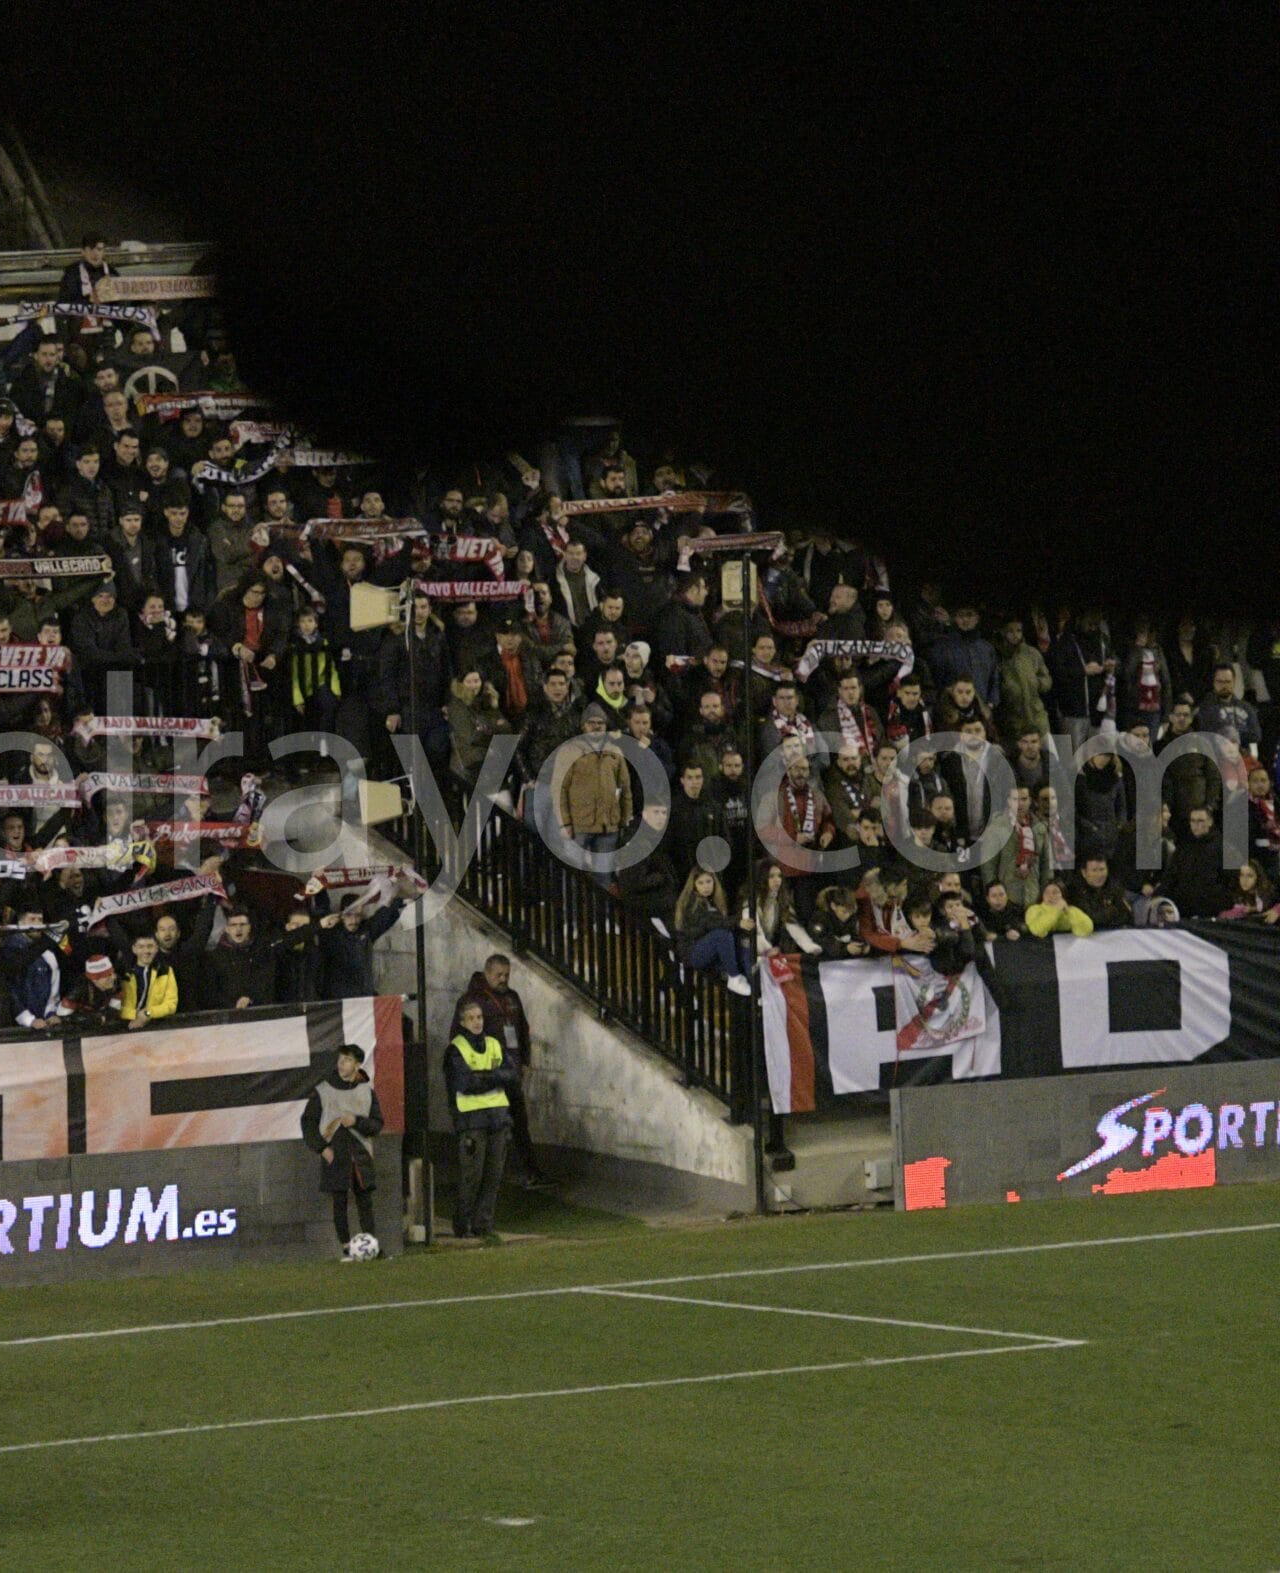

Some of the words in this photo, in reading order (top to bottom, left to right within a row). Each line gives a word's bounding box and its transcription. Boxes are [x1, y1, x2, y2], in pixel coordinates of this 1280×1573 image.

[455, 581, 523, 596] VALLECANO
[815, 640, 911, 660] BUKANEROS
[103, 717, 133, 731] RAYO
[135, 717, 197, 731] VALLECANO
[154, 823, 243, 844] Bukaneros
[1056, 1087, 1280, 1181] SPORT
